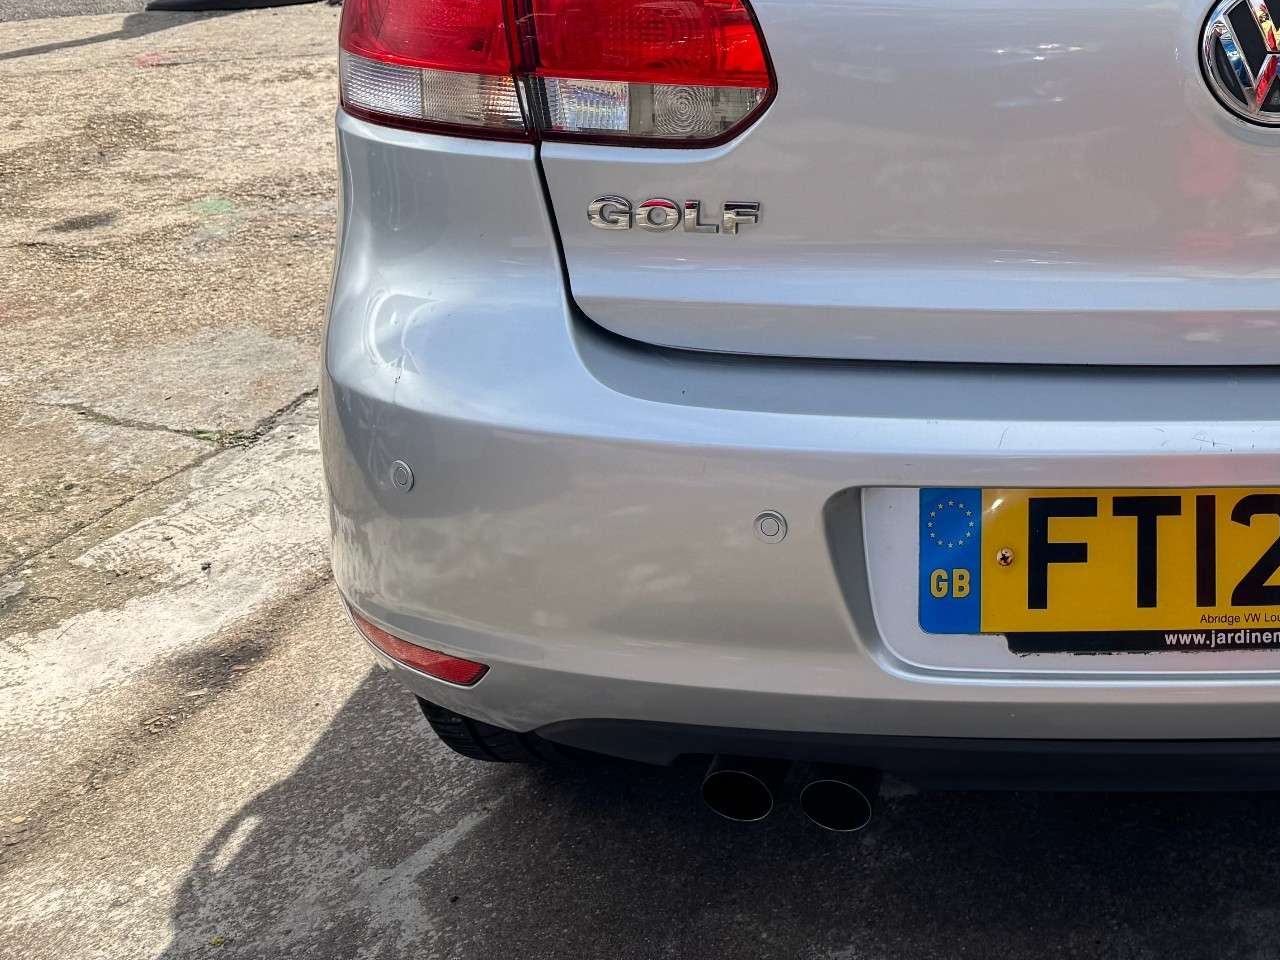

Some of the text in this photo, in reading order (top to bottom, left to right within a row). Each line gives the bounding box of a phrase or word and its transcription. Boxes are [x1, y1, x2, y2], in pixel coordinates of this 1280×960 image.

[587, 194, 760, 235] GOLF
[930, 569, 970, 598] GB
[1200, 614, 1240, 625] Abridge
[1244, 613, 1260, 623] VW
